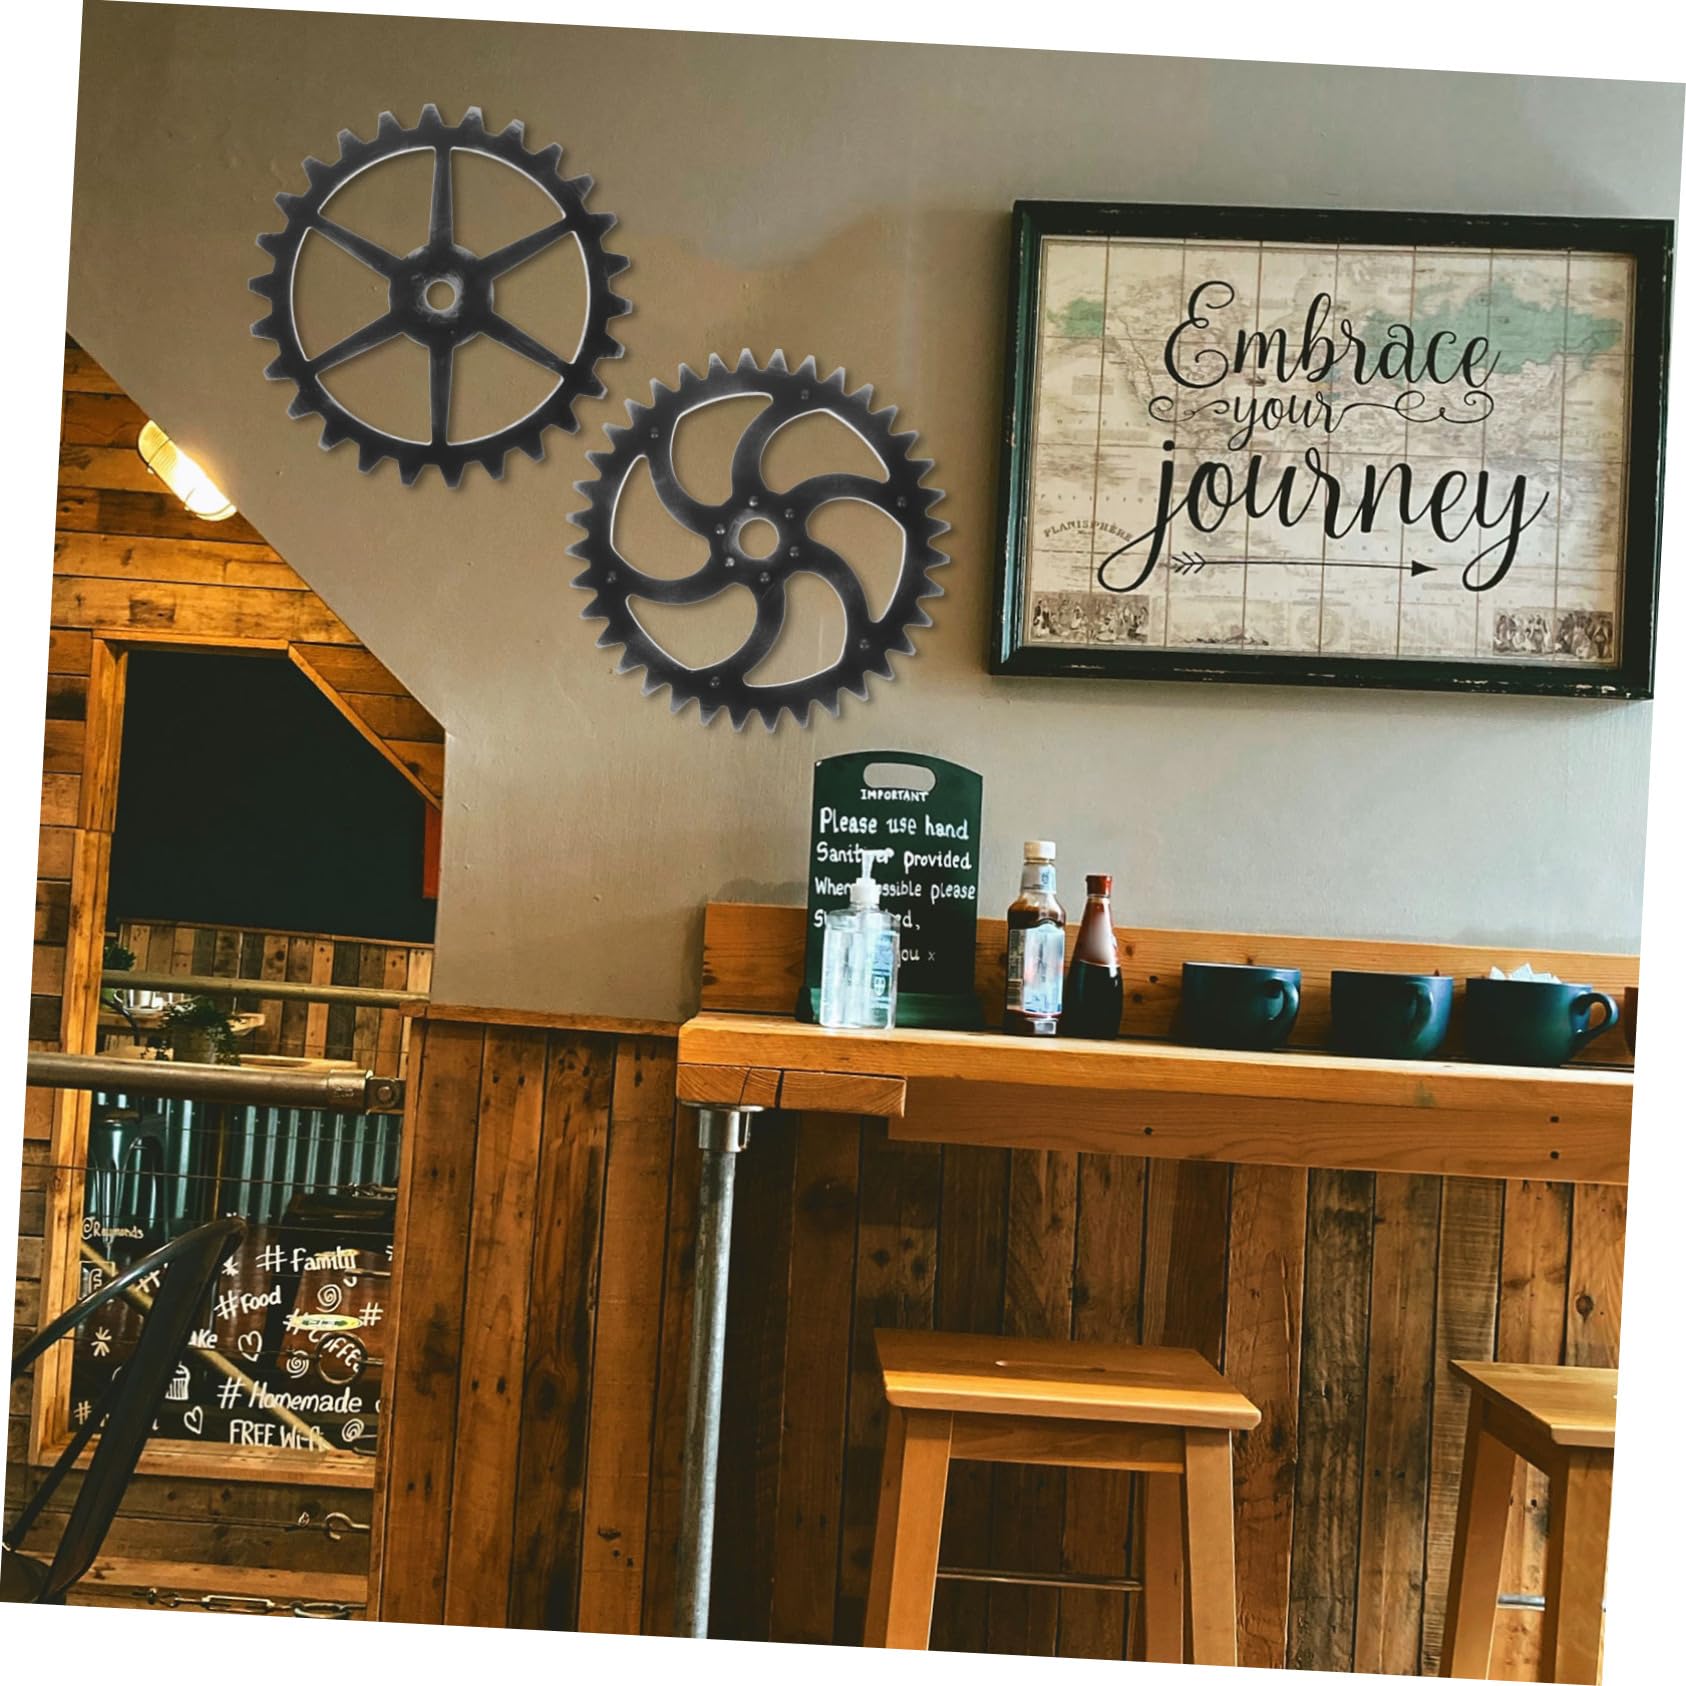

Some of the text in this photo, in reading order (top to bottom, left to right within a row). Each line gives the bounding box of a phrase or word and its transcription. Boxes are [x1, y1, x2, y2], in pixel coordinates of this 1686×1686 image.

[1164, 281, 1502, 389] Embrace
[1097, 440, 1550, 592] journey
[860, 788, 930, 802] IMPORTANT
[819, 807, 969, 840] Please use hand
[903, 850, 972, 875] provided
[814, 876, 976, 904] Wher ssible please
[230, 1419, 276, 1447] FREE
